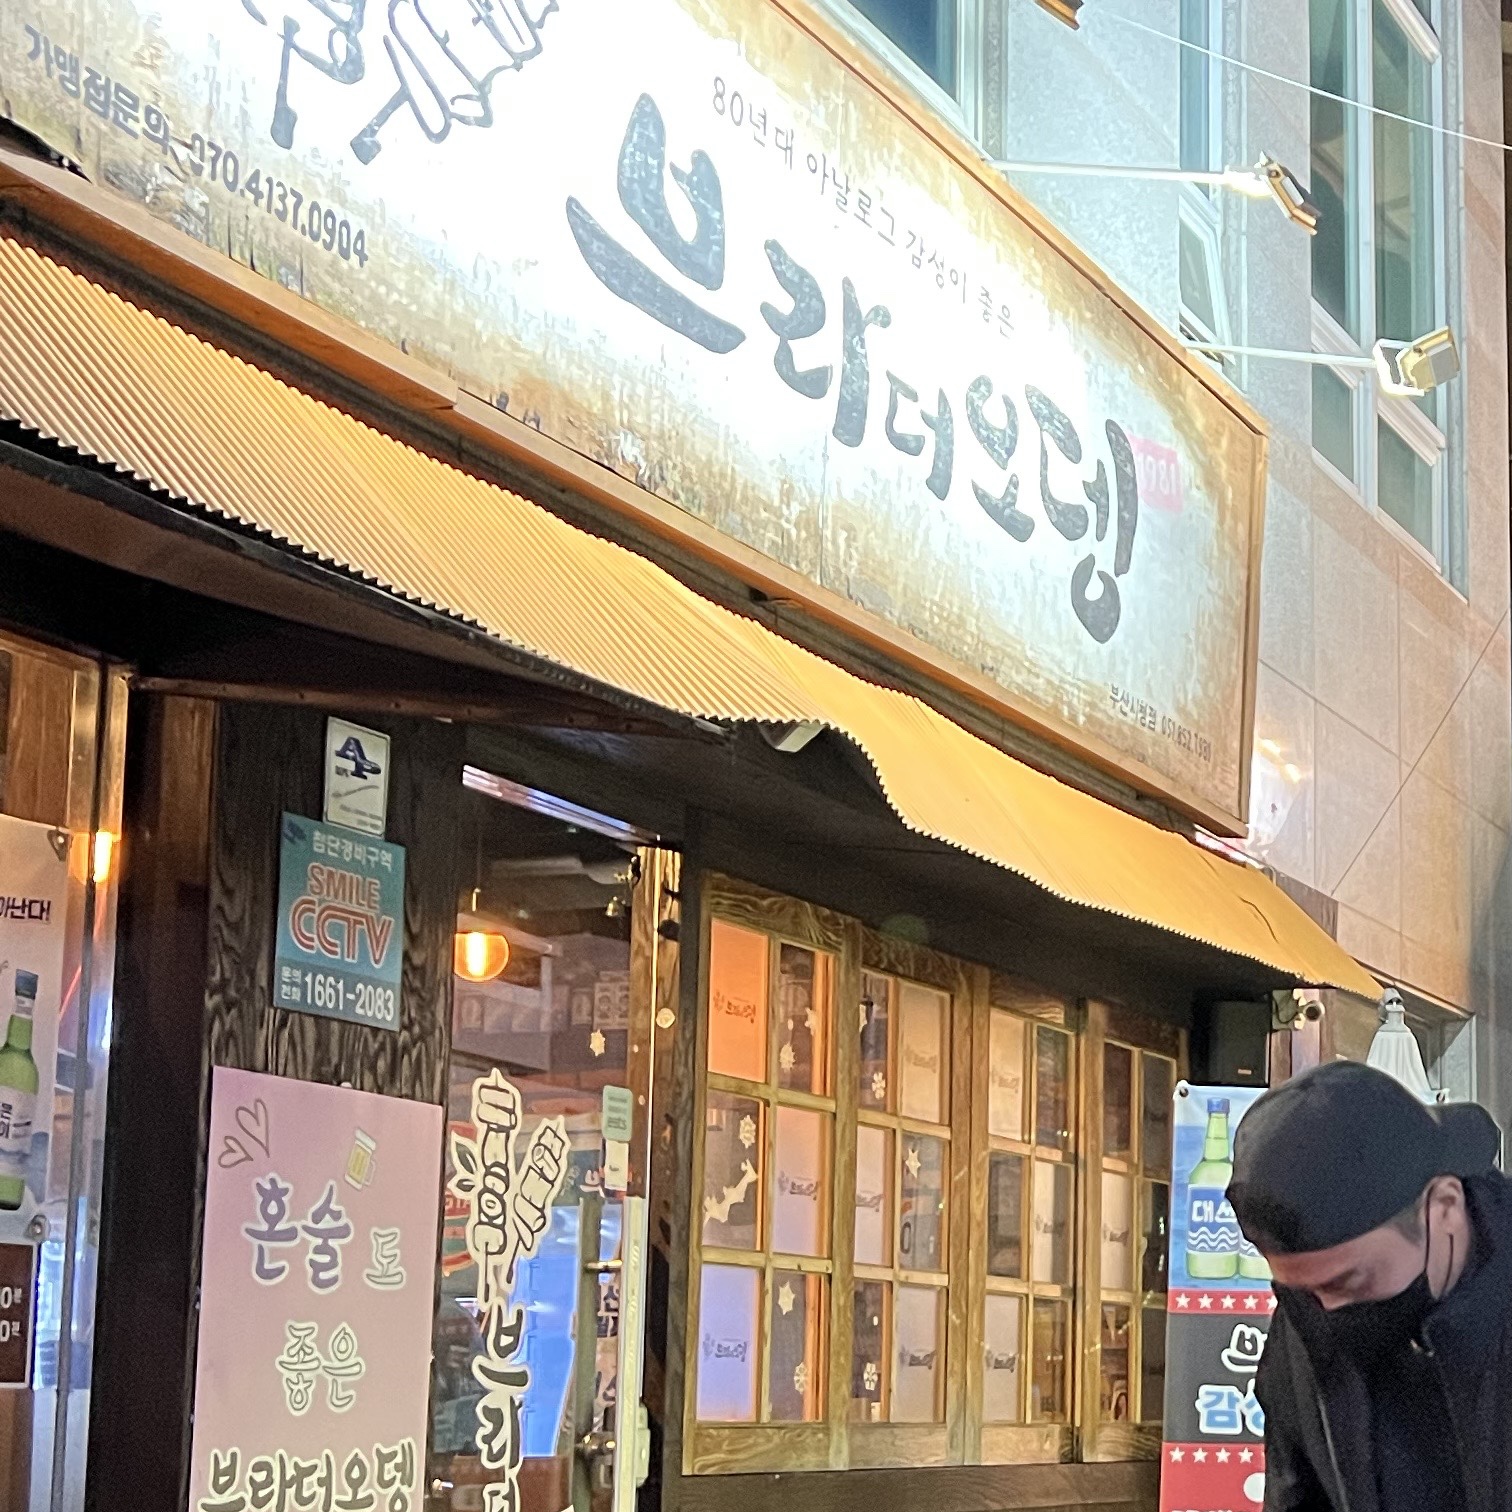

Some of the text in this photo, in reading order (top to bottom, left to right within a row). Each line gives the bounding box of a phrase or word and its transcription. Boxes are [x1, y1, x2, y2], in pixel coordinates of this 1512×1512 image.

[190, 133, 369, 267] 070.4137.0904
[713, 77, 794, 170] 80년대
[807, 153, 895, 247] 아날로그
[906, 230, 967, 303] 감성이
[566, 92, 1139, 643] 브라더오뎅
[290, 896, 394, 968] CCTV
[307, 862, 381, 911] SMILE
[304, 972, 394, 1021] 1661-2083
[245, 1176, 404, 1289] 혼술 도
[279, 1324, 363, 1412] 좋은
